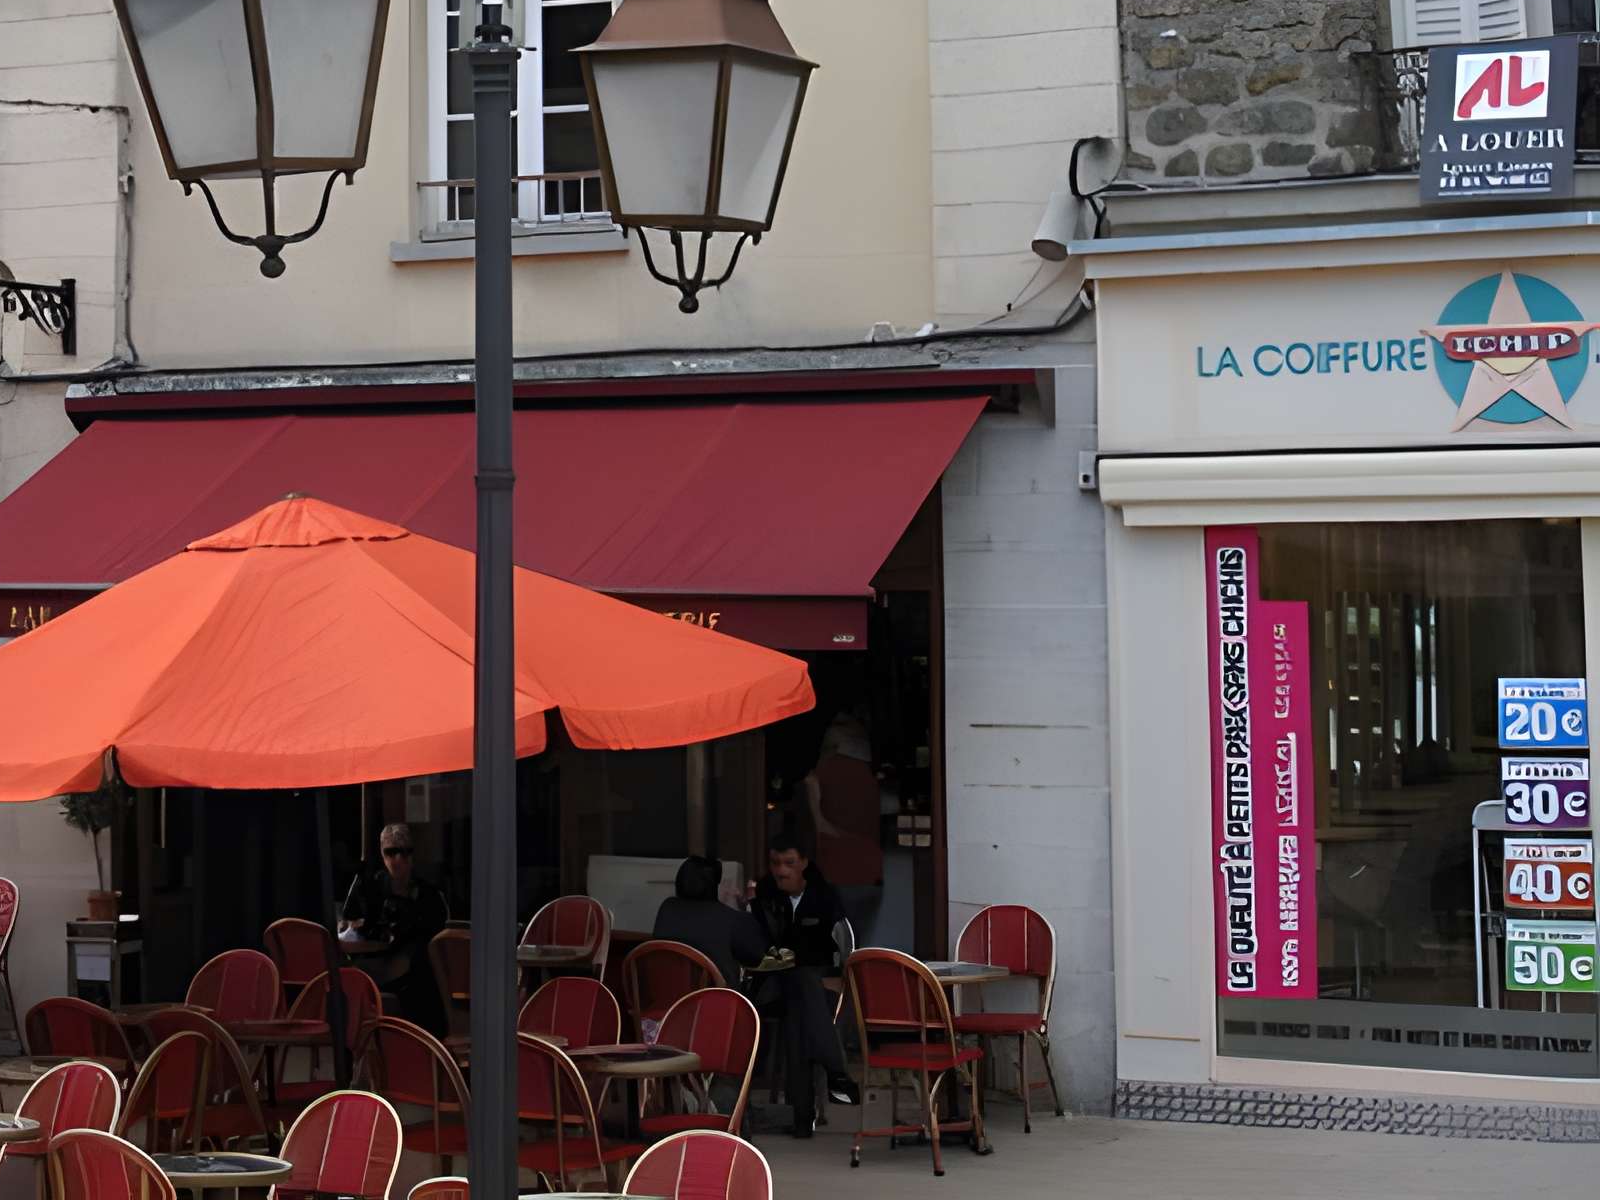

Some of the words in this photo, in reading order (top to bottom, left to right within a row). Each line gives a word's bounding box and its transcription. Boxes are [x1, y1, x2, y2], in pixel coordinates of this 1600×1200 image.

[1460, 128, 1565, 152] LOUER
[1196, 345, 1244, 378] LA
[1252, 337, 1428, 378] COIFFURE
